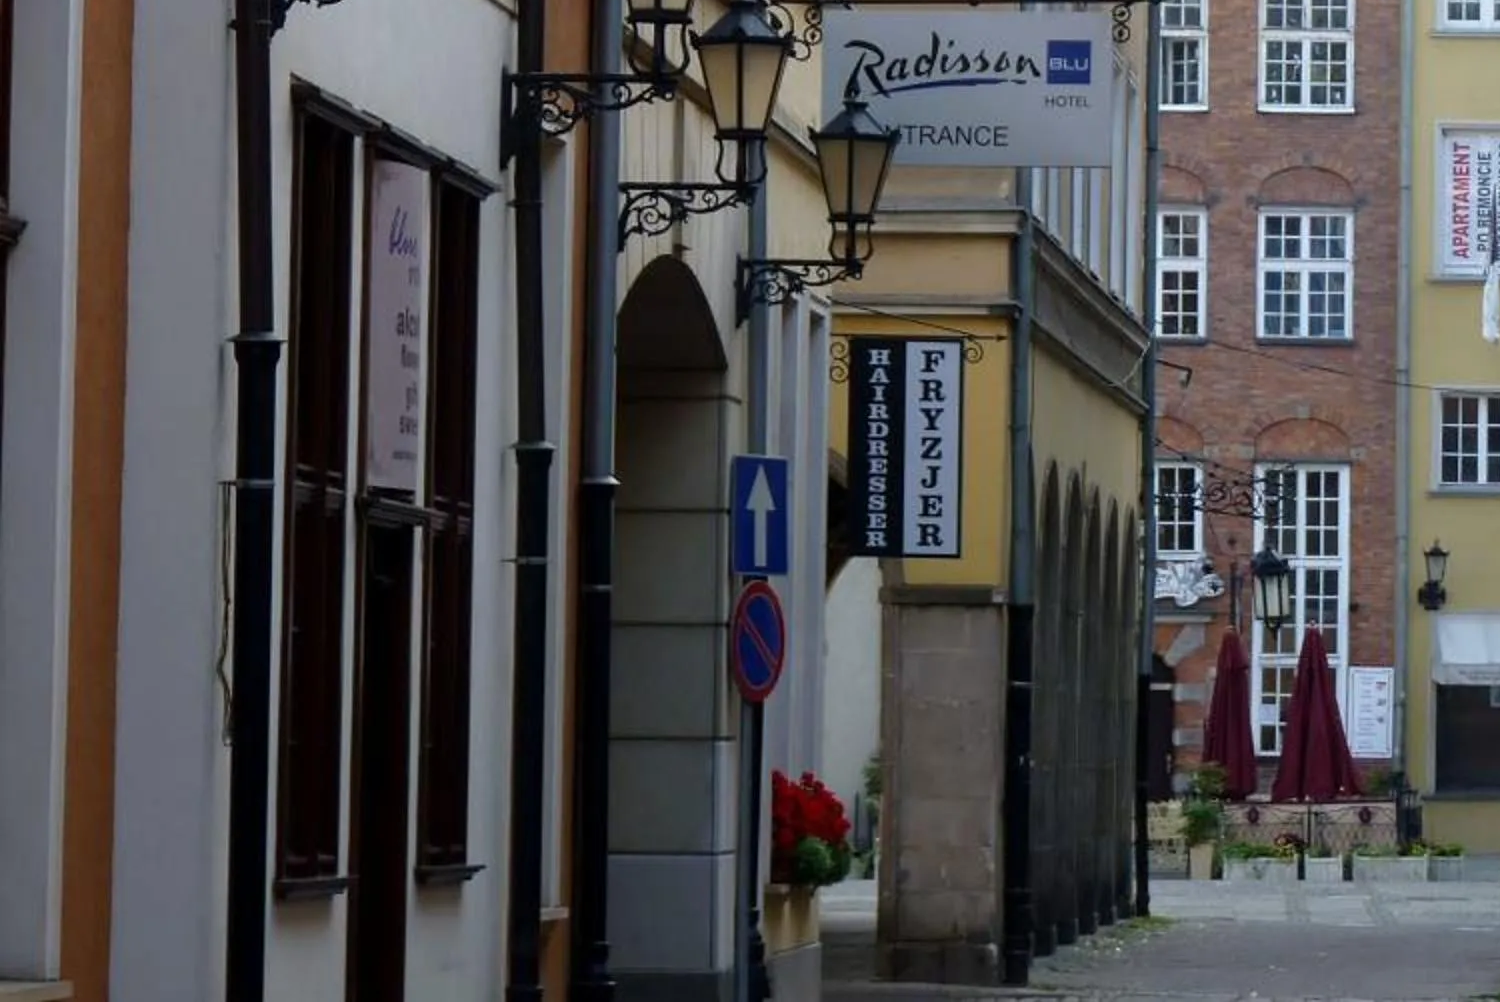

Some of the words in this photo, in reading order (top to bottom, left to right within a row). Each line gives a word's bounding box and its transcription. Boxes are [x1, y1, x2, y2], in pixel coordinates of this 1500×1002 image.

[843, 31, 1041, 99] Radisson
[1049, 56, 1089, 71] BLU
[1044, 95, 1091, 108] HOTEL
[1452, 142, 1471, 259] APARTAMENT
[1477, 151, 1492, 228] REMONCIE
[866, 349, 891, 546] HAIRDRESSER
[917, 350, 945, 546] FRYZJER
